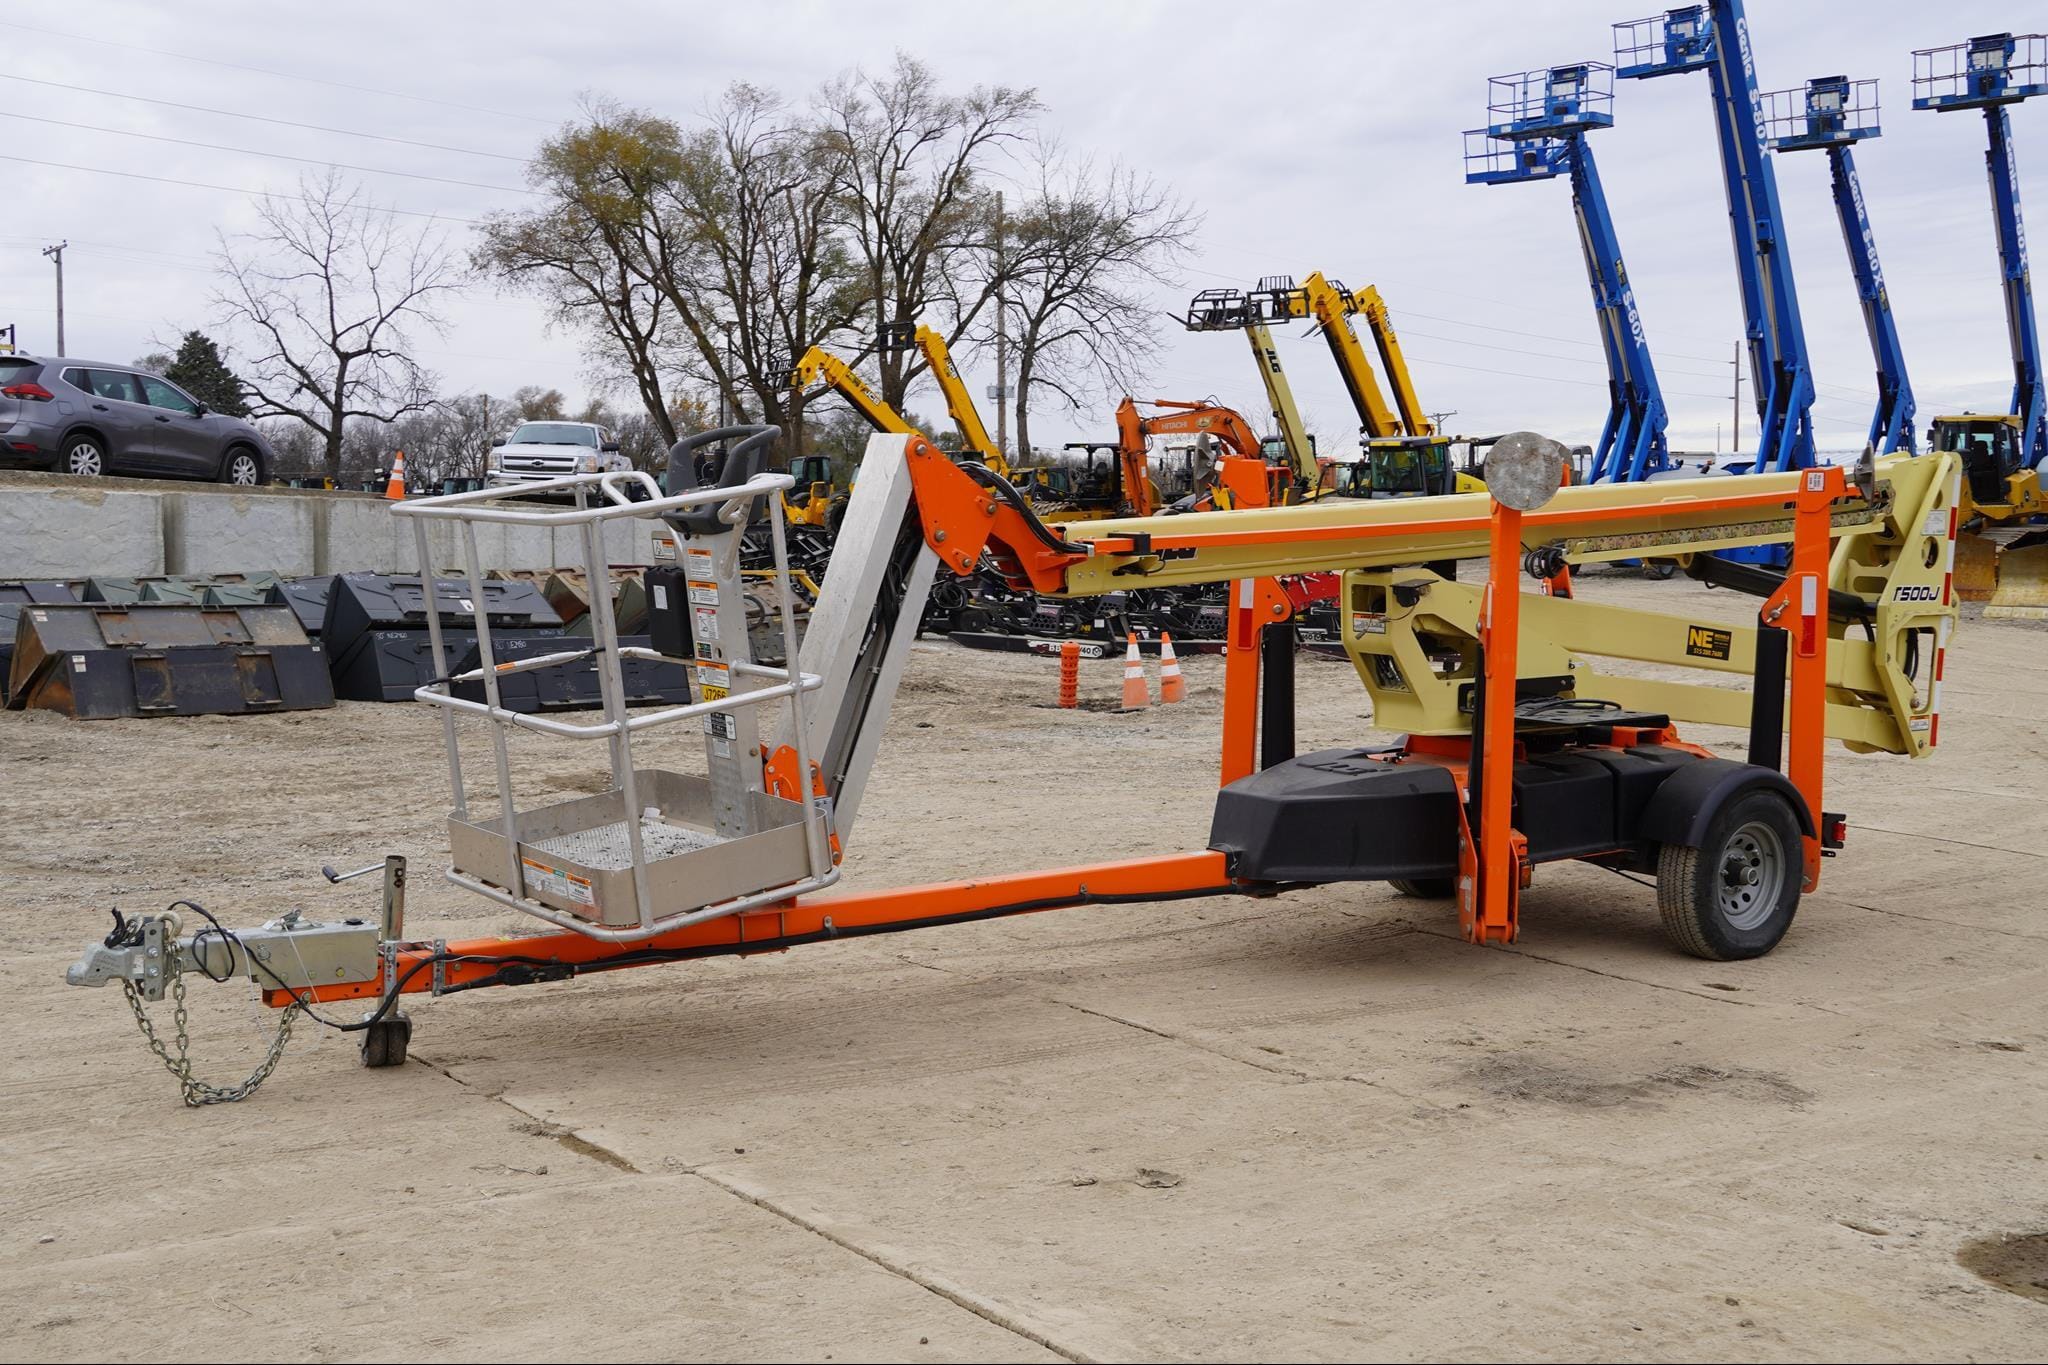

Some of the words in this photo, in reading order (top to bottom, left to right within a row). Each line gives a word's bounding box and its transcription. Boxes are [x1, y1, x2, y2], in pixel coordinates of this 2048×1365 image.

[1736, 17, 1753, 80] Genie
[1848, 170, 1866, 222] Genie
[1623, 290, 1646, 350] S-60X
[1265, 347, 1282, 373] JLG
[1161, 420, 1188, 430] HITACHI
[1688, 628, 1714, 648] NE
[704, 688, 727, 700] J7266
